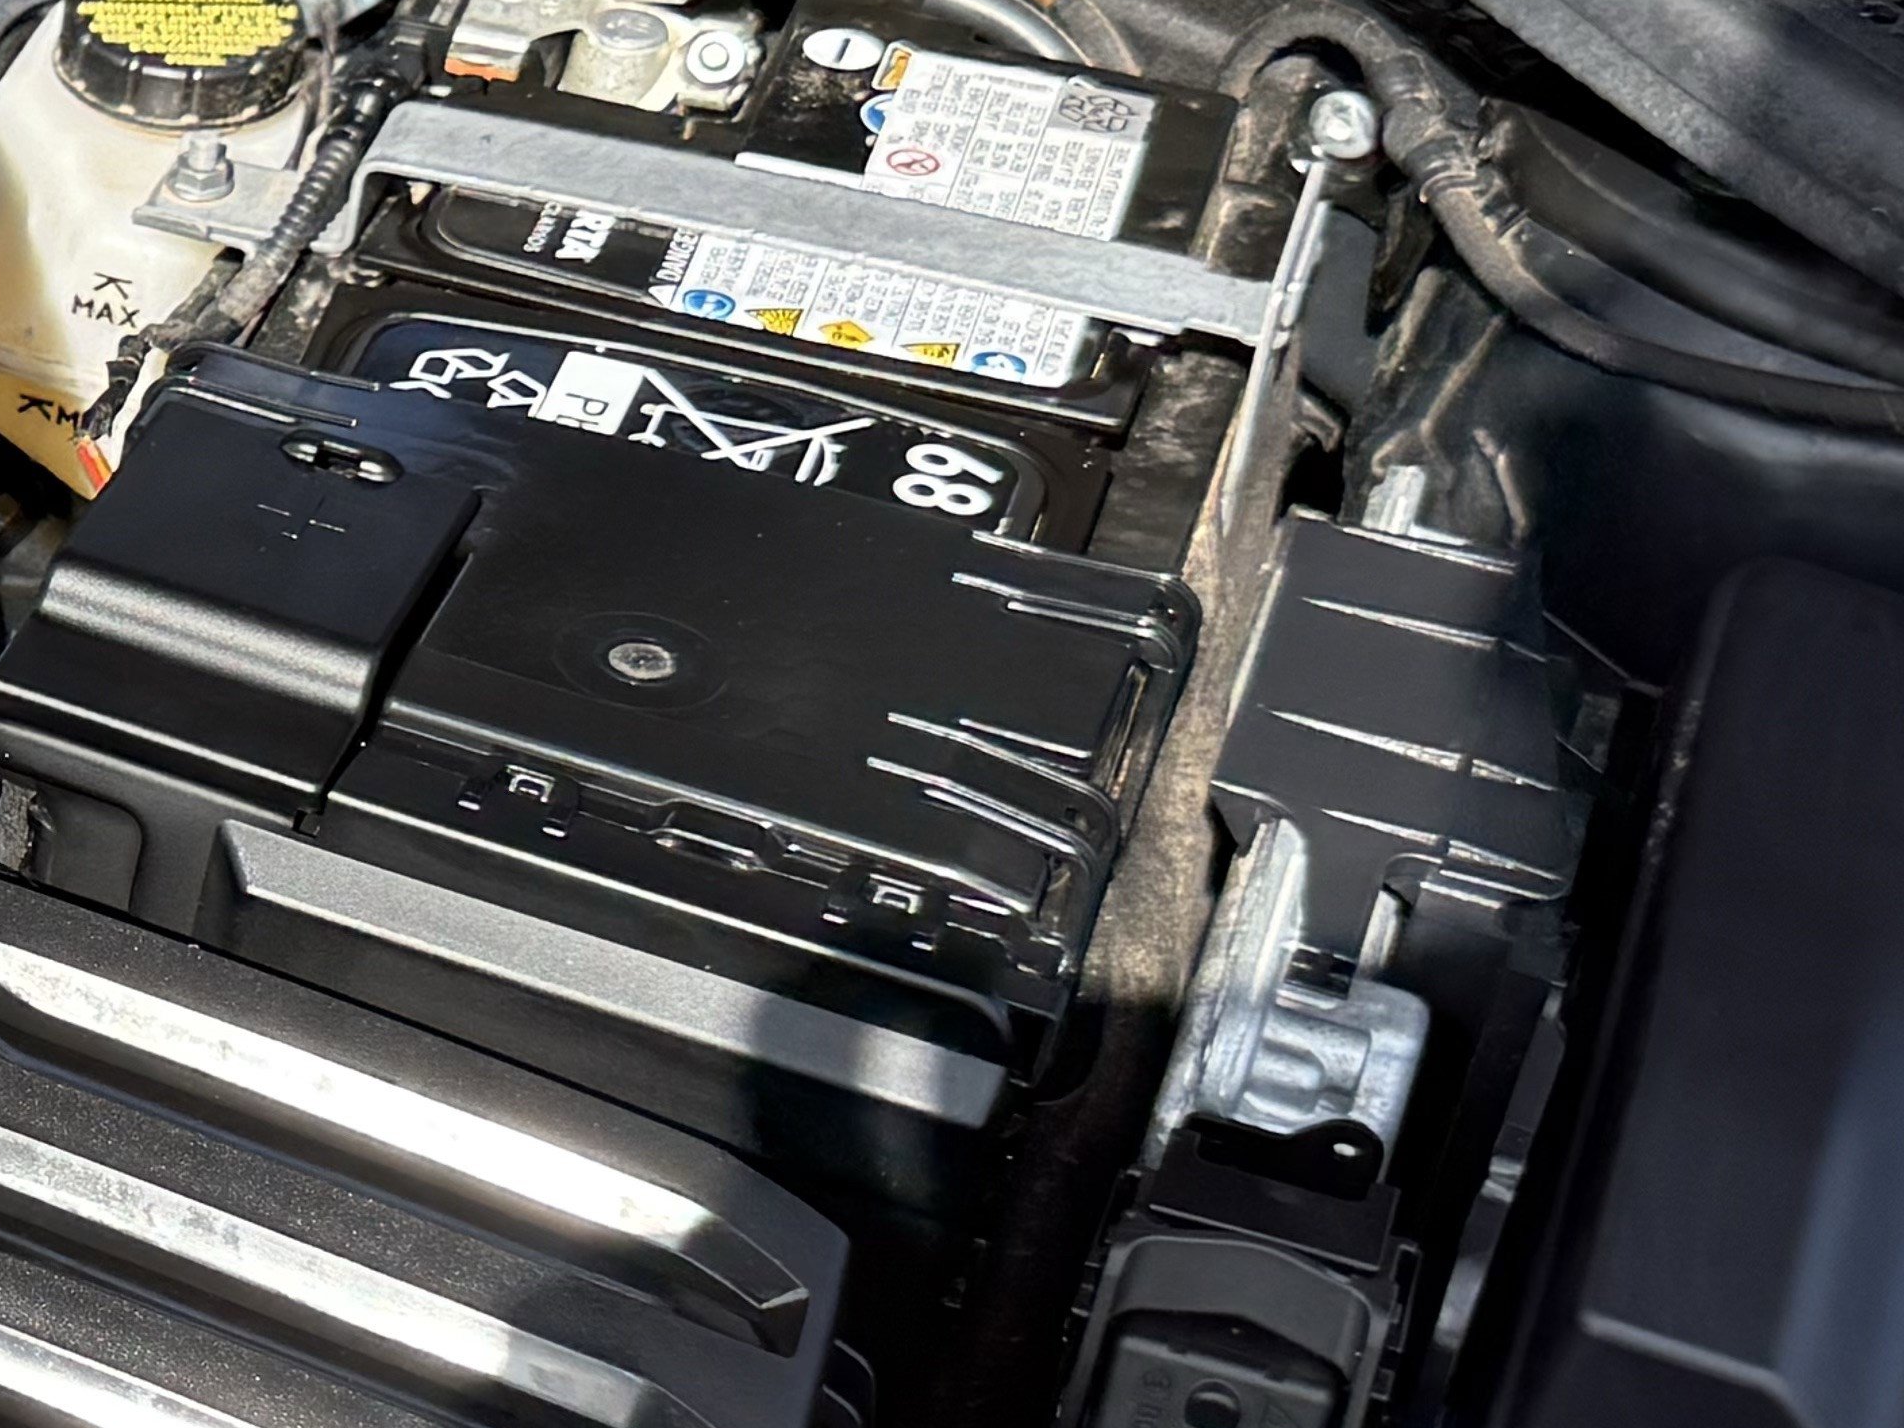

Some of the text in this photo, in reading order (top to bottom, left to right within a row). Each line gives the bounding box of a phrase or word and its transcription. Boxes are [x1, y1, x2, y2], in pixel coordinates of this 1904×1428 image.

[554, 210, 617, 264] RTA
[654, 228, 700, 287] DANGE
[72, 294, 139, 328] MAX
[891, 442, 1005, 517] 68
